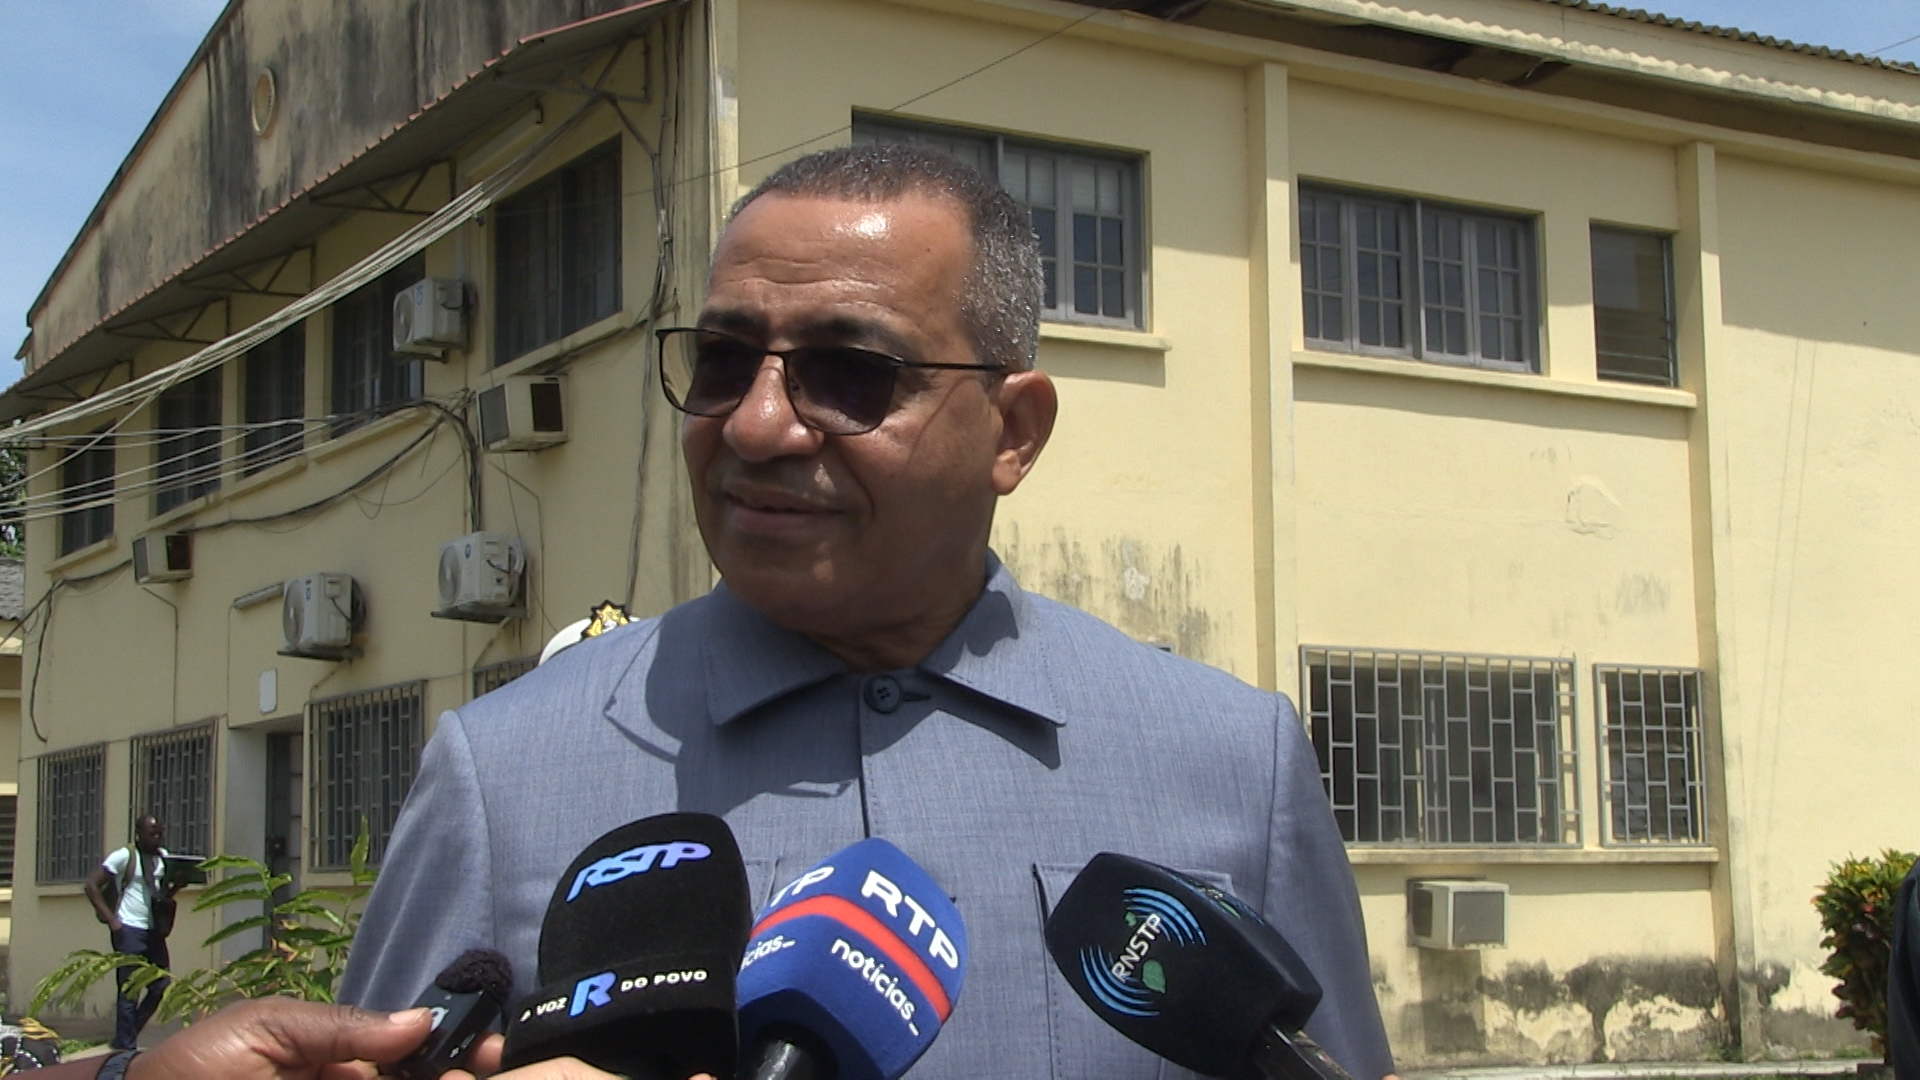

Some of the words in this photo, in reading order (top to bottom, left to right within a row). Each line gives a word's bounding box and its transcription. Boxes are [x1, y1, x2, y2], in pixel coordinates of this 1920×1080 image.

[768, 866, 835, 908] TP
[861, 869, 959, 969] RTP
[1111, 913, 1161, 984] RNSTP
[536, 997, 568, 1016] VOZ
[620, 977, 648, 992] DO
[654, 970, 707, 985] POVO
